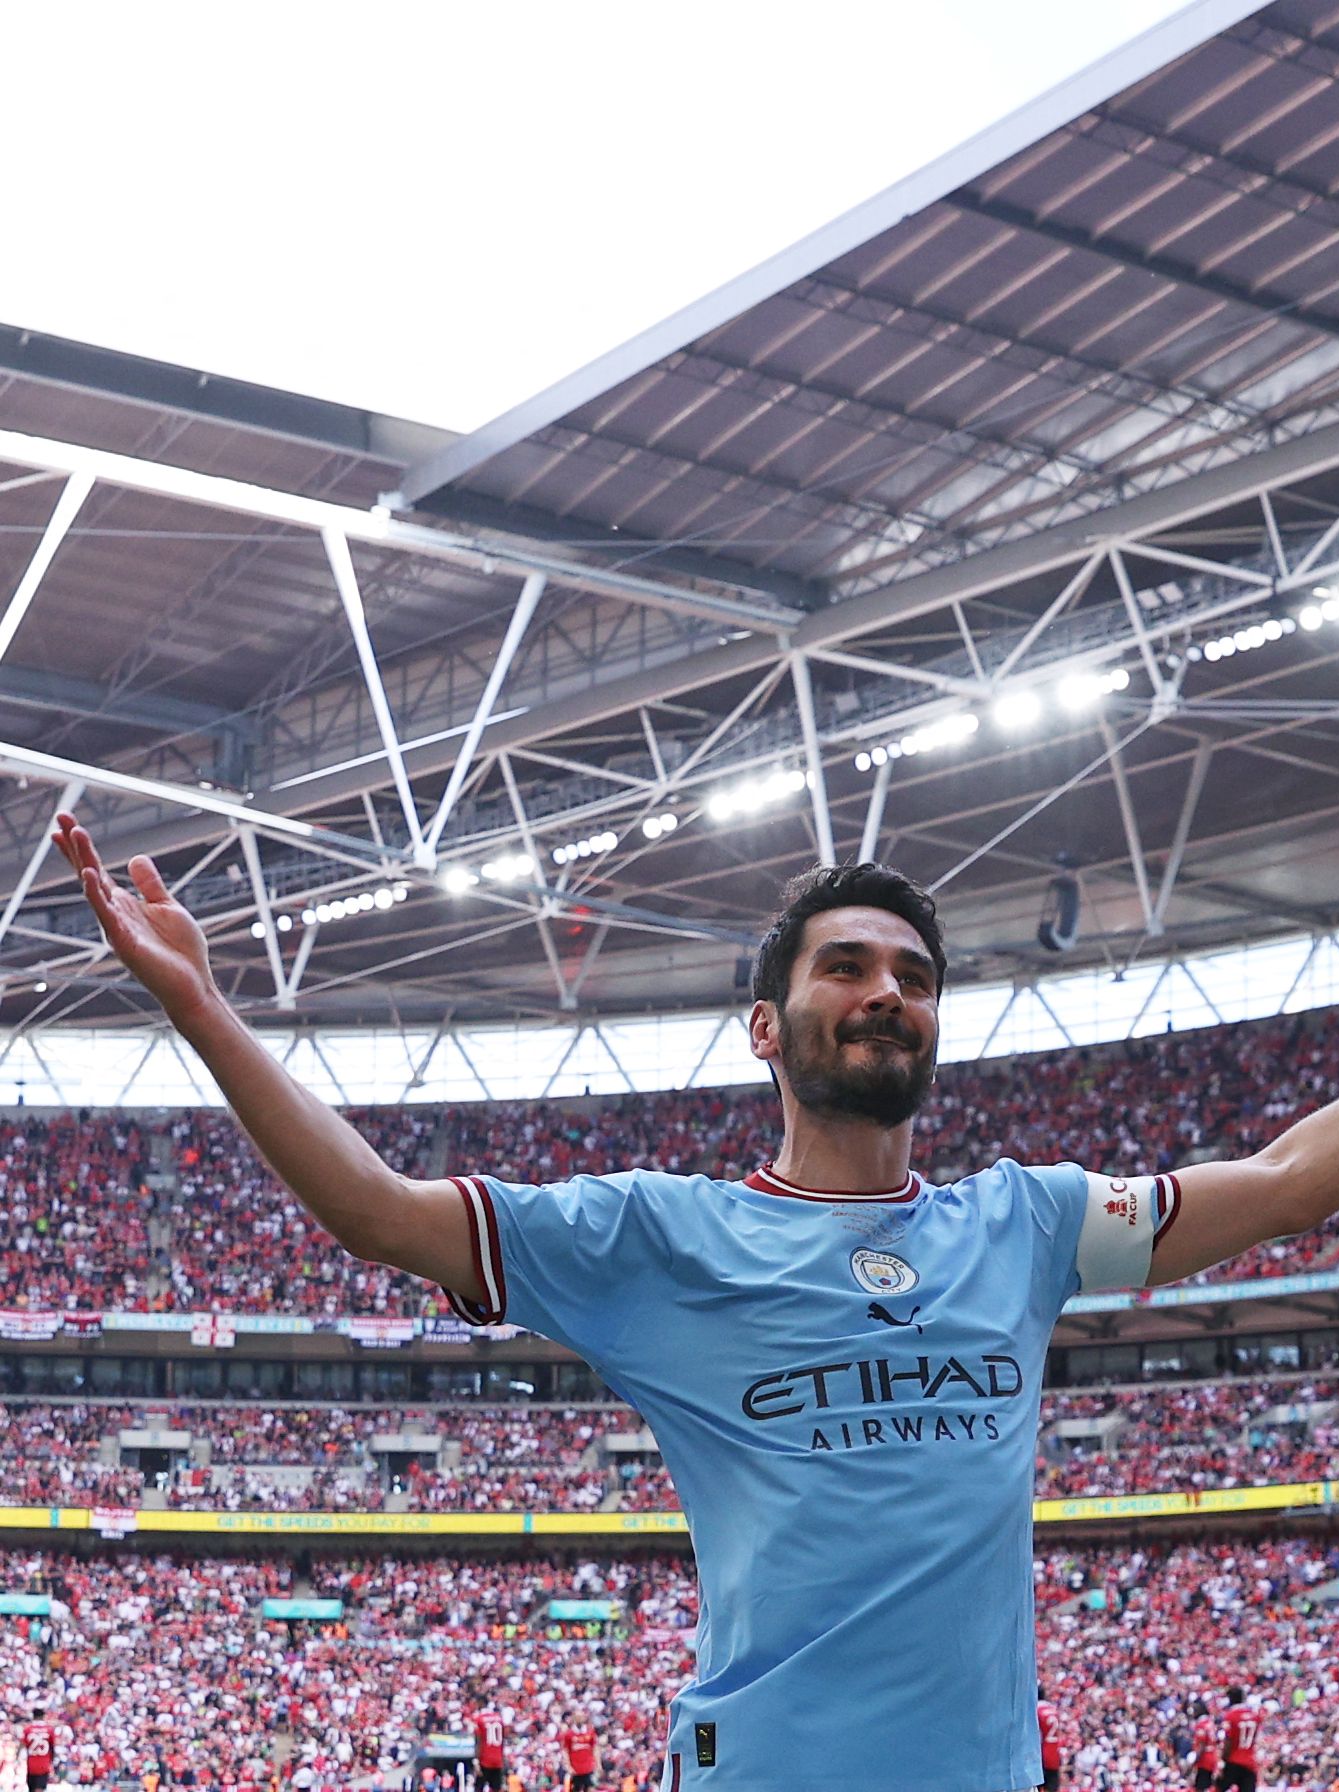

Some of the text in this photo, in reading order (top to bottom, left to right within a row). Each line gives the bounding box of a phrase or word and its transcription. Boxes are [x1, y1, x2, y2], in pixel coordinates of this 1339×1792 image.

[1128, 1193, 1137, 1225] FA CUP
[854, 1252, 904, 1269] MANCHESTER
[741, 1355, 1023, 1420] ETIHAD
[811, 1413, 1000, 1451] AIRWAYS
[218, 1515, 242, 1529] GET
[248, 1515, 275, 1529] THE
[280, 1515, 333, 1529] SPEEDS
[27, 1732, 50, 1756] 25
[486, 1721, 503, 1747] 10
[1238, 1720, 1257, 1749] 17
